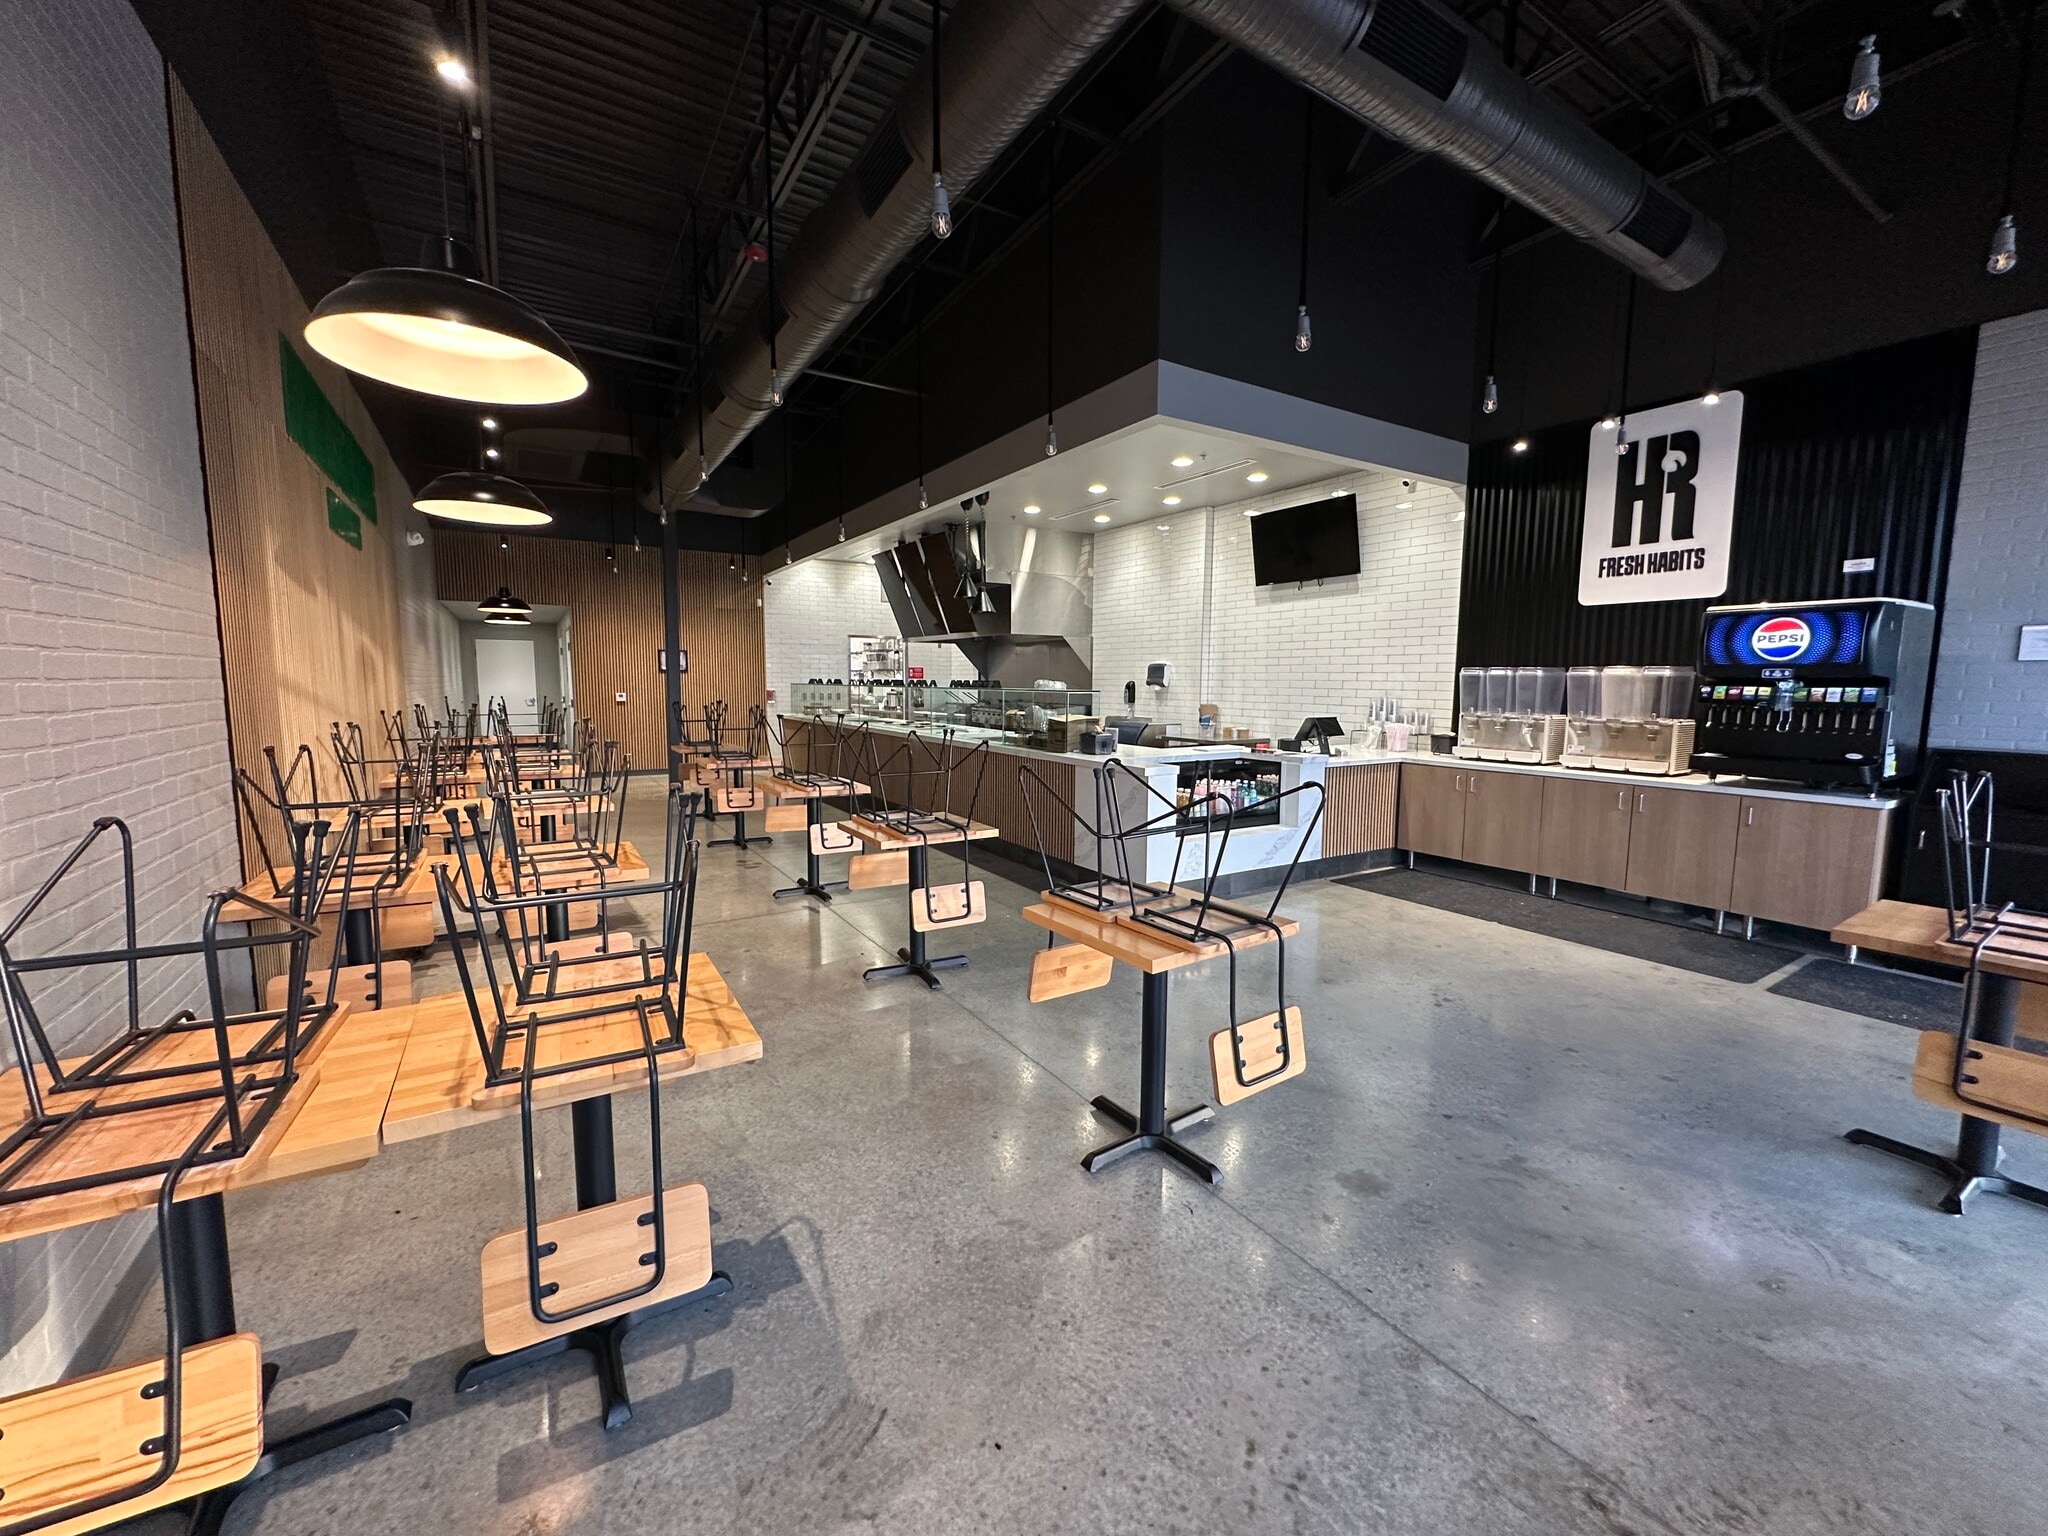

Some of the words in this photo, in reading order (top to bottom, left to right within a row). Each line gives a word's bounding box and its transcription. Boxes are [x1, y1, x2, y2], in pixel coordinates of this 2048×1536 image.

[1598, 554, 1645, 578] FRESH
[1647, 547, 1706, 574] HABITS
[1757, 633, 1805, 643] PEPSI
